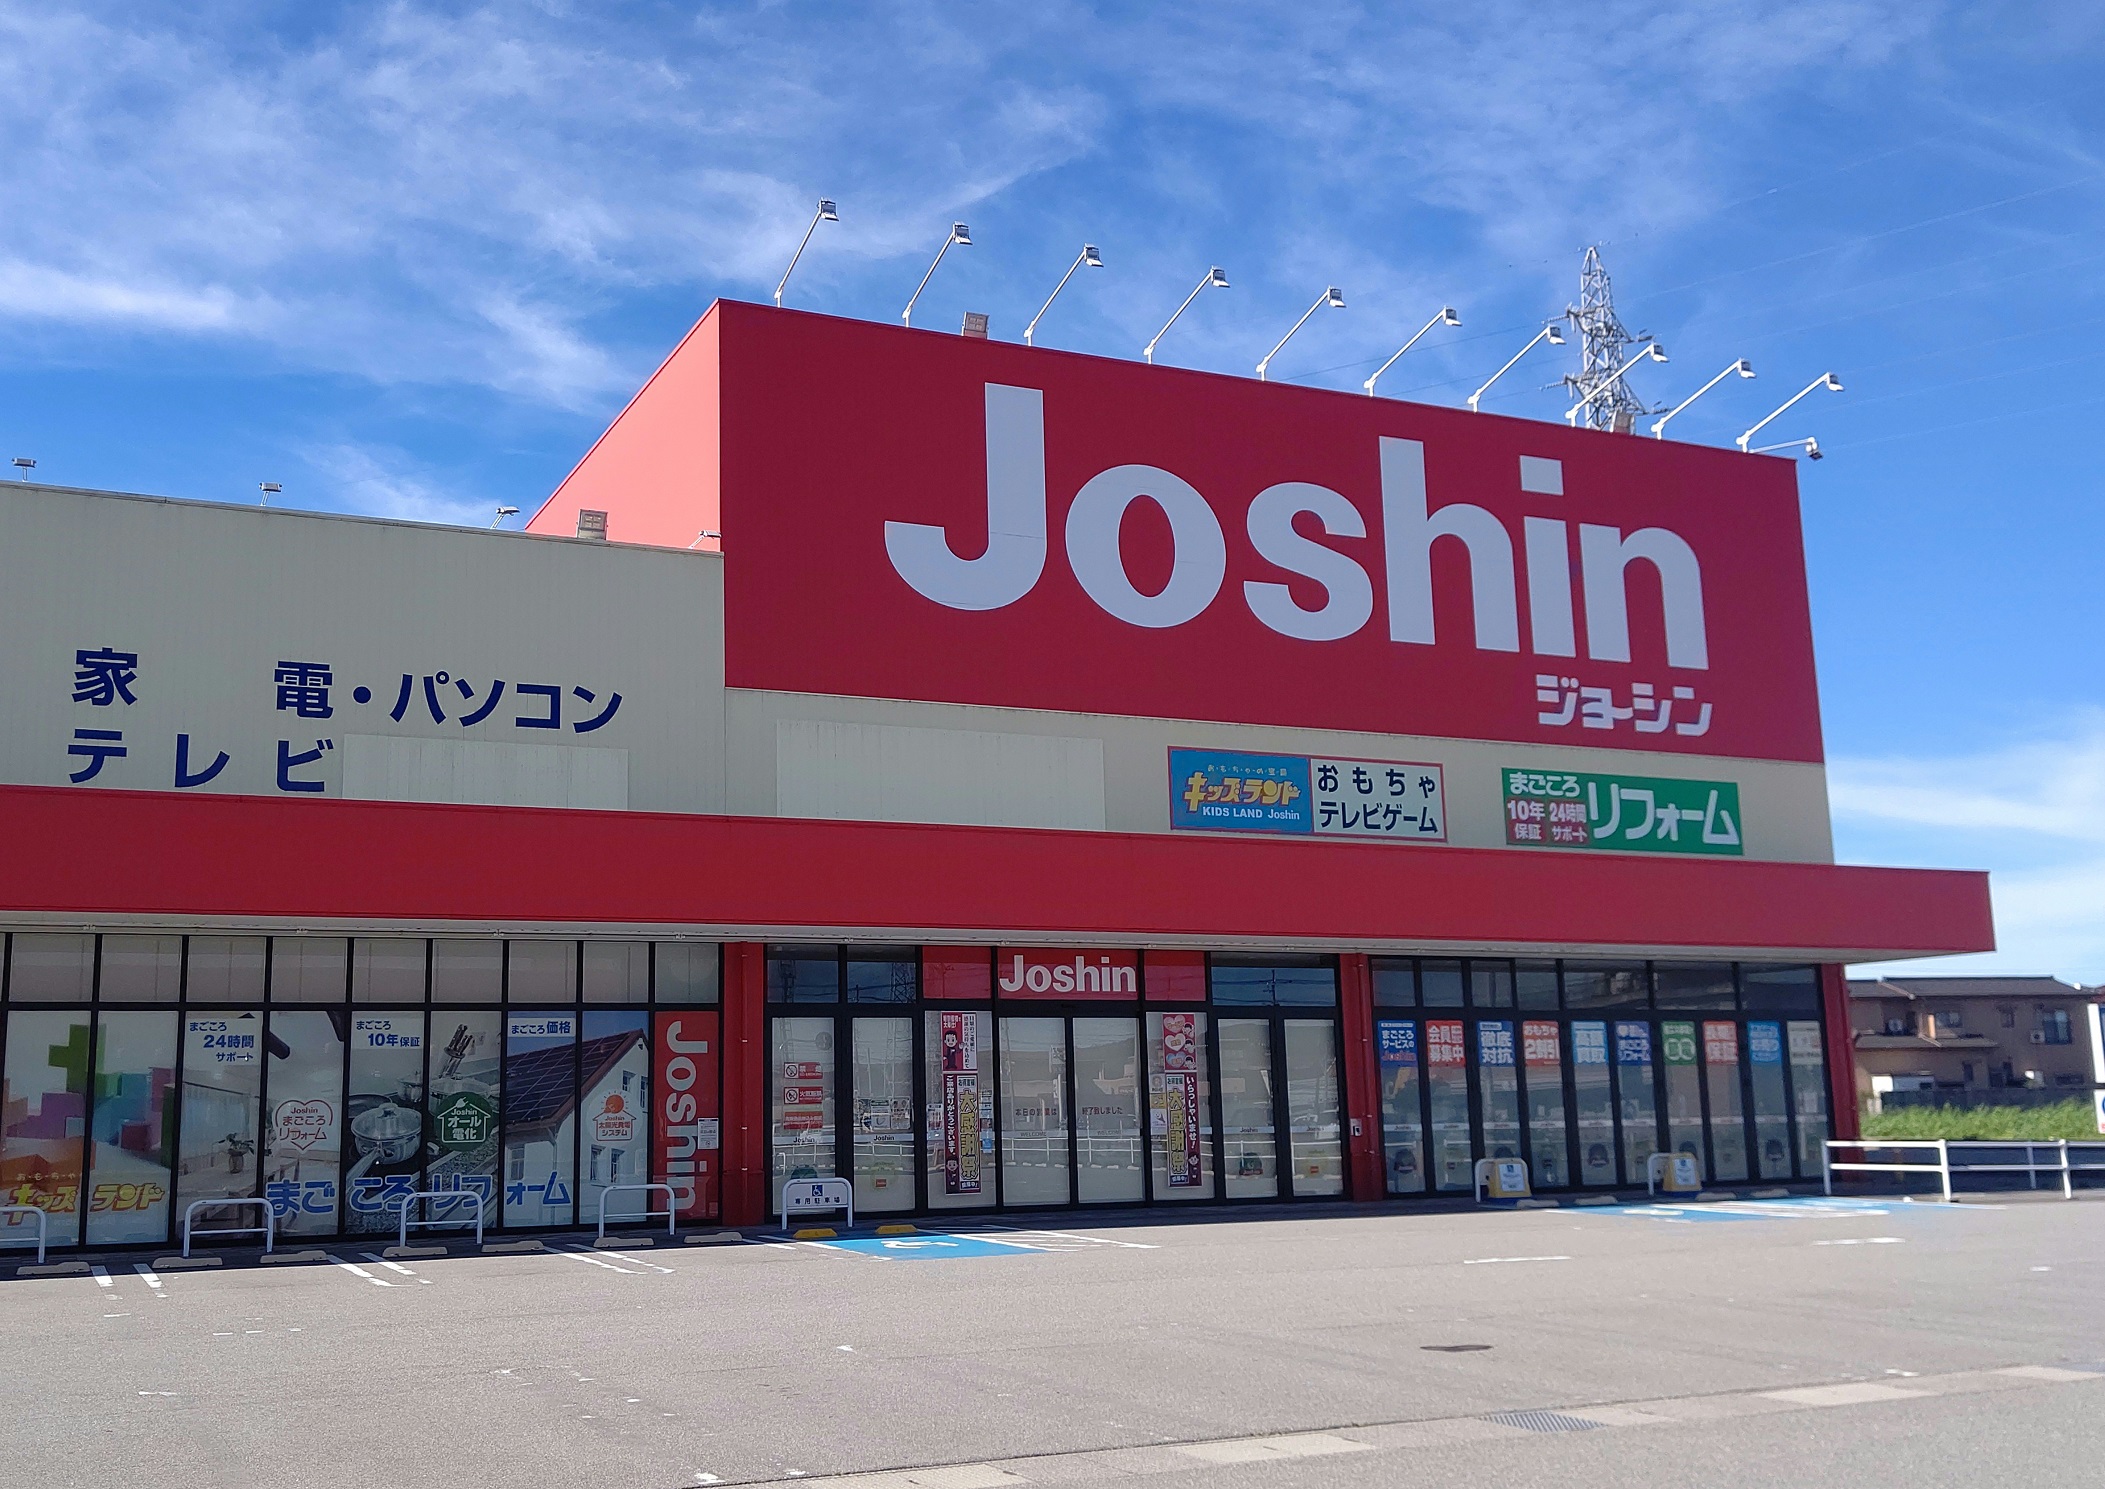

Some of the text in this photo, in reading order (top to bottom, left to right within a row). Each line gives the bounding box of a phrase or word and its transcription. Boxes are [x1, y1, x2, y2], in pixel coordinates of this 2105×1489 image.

[883, 382, 1709, 670] Joshin
[1535, 673, 1713, 737] ジョーシン
[67, 728, 335, 793] テレビ
[1317, 764, 1436, 799] おもちゃ
[1509, 771, 1581, 798] まごころ
[1184, 771, 1302, 813] キッズランド
[1202, 805, 1301, 821] KIDS LAND Joshin
[1319, 800, 1439, 835] テレビゲーム
[1507, 799, 1546, 821] 10年
[1549, 801, 1588, 824] 24時間
[1587, 781, 1740, 846] リフォーム
[1513, 822, 1542, 841] 保証
[1551, 824, 1588, 843] サポート
[999, 953, 1137, 993] Joshin
[189, 1021, 228, 1032] まごころ
[355, 1020, 392, 1031] まごころ
[510, 1020, 572, 1035] まごころ価格
[1381, 1029, 1415, 1040] まごころ
[203, 1034, 255, 1049] 24時間
[215, 1052, 254, 1063] サポート
[290, 1106, 319, 1115] Joshin
[450, 1107, 478, 1116] Joshin
[665, 1020, 708, 1210] Joshin
[282, 1115, 327, 1126] まごころ
[447, 1116, 482, 1129] オール
[279, 1127, 328, 1141] リフォーム
[452, 1128, 478, 1141] 電化
[873, 1134, 895, 1142] Joshin
[959, 1088, 978, 1181] 大感謝祭
[1168, 1087, 1187, 1176] 大感謝祭
